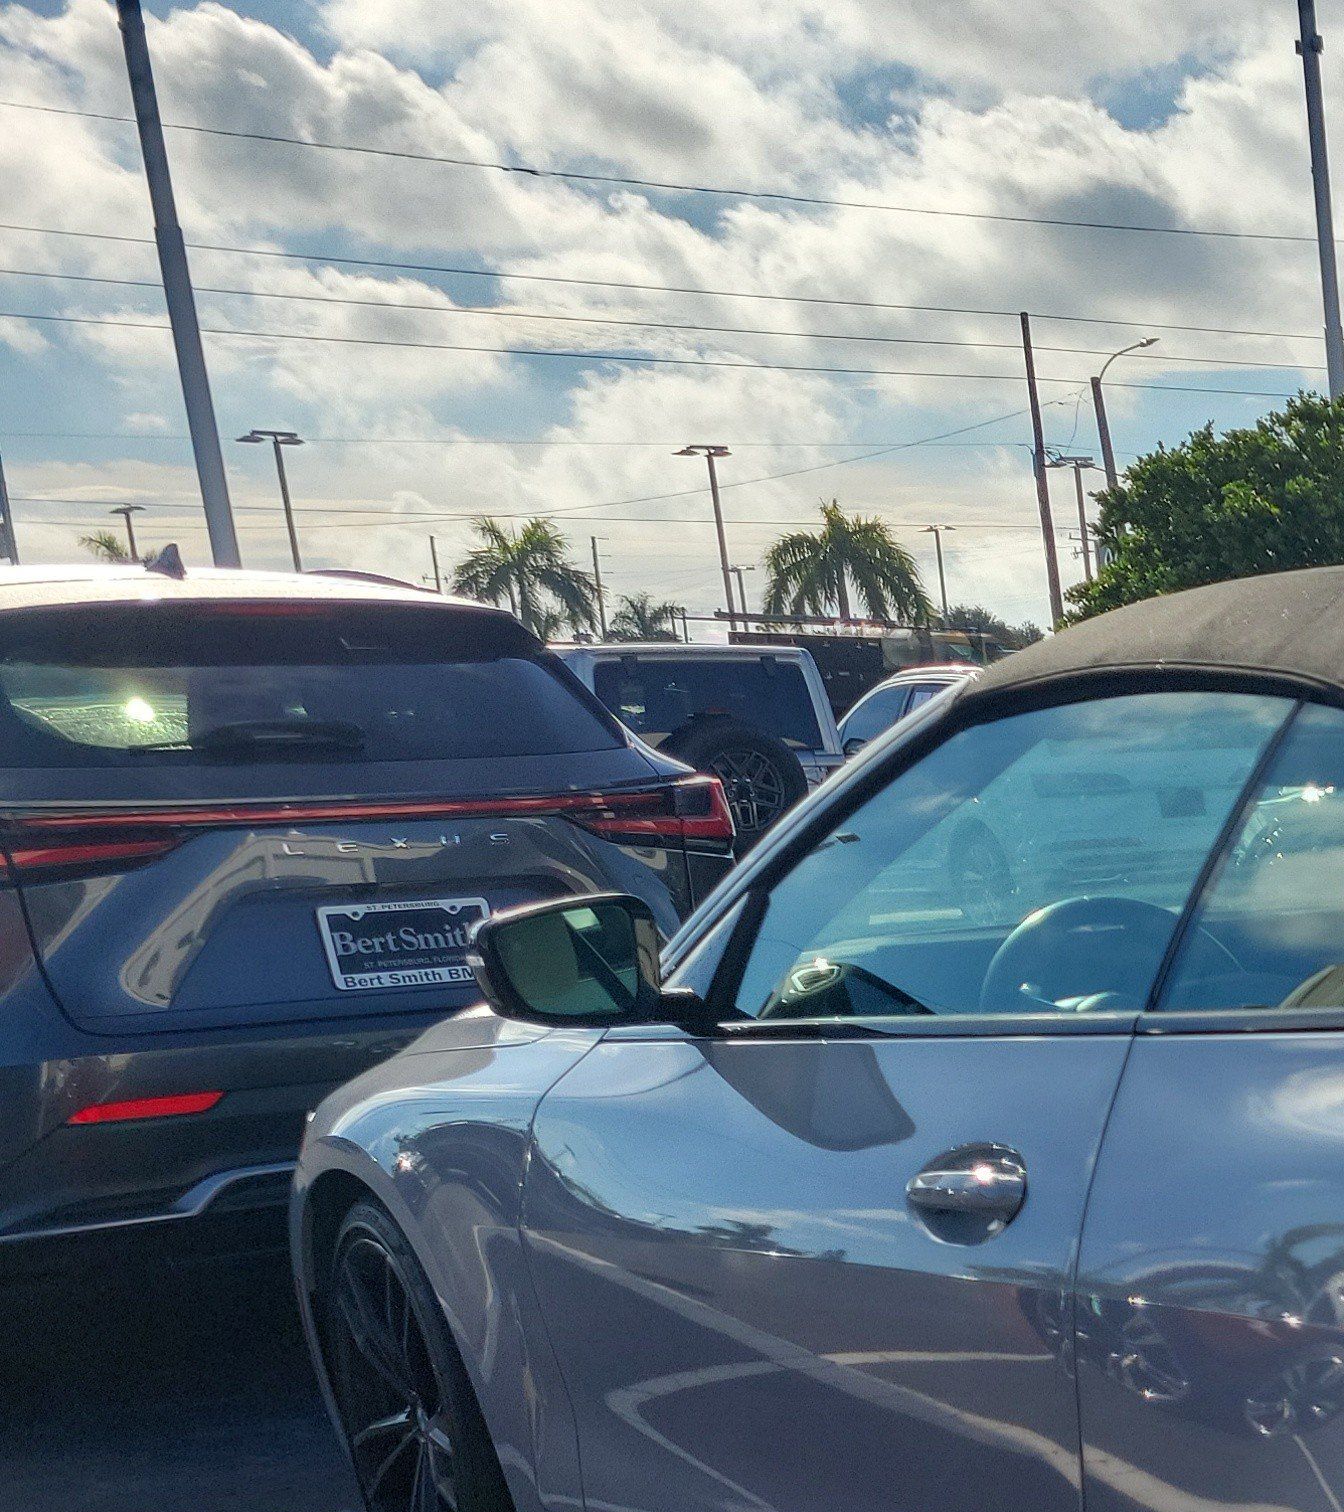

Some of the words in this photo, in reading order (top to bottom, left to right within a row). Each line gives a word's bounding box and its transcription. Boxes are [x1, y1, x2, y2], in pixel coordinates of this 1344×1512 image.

[283, 833, 509, 856] LEXUS
[382, 901, 440, 911] PETERSBURG
[344, 975, 384, 989] Bert
[389, 970, 442, 985] Smith
[449, 966, 476, 980] BM
